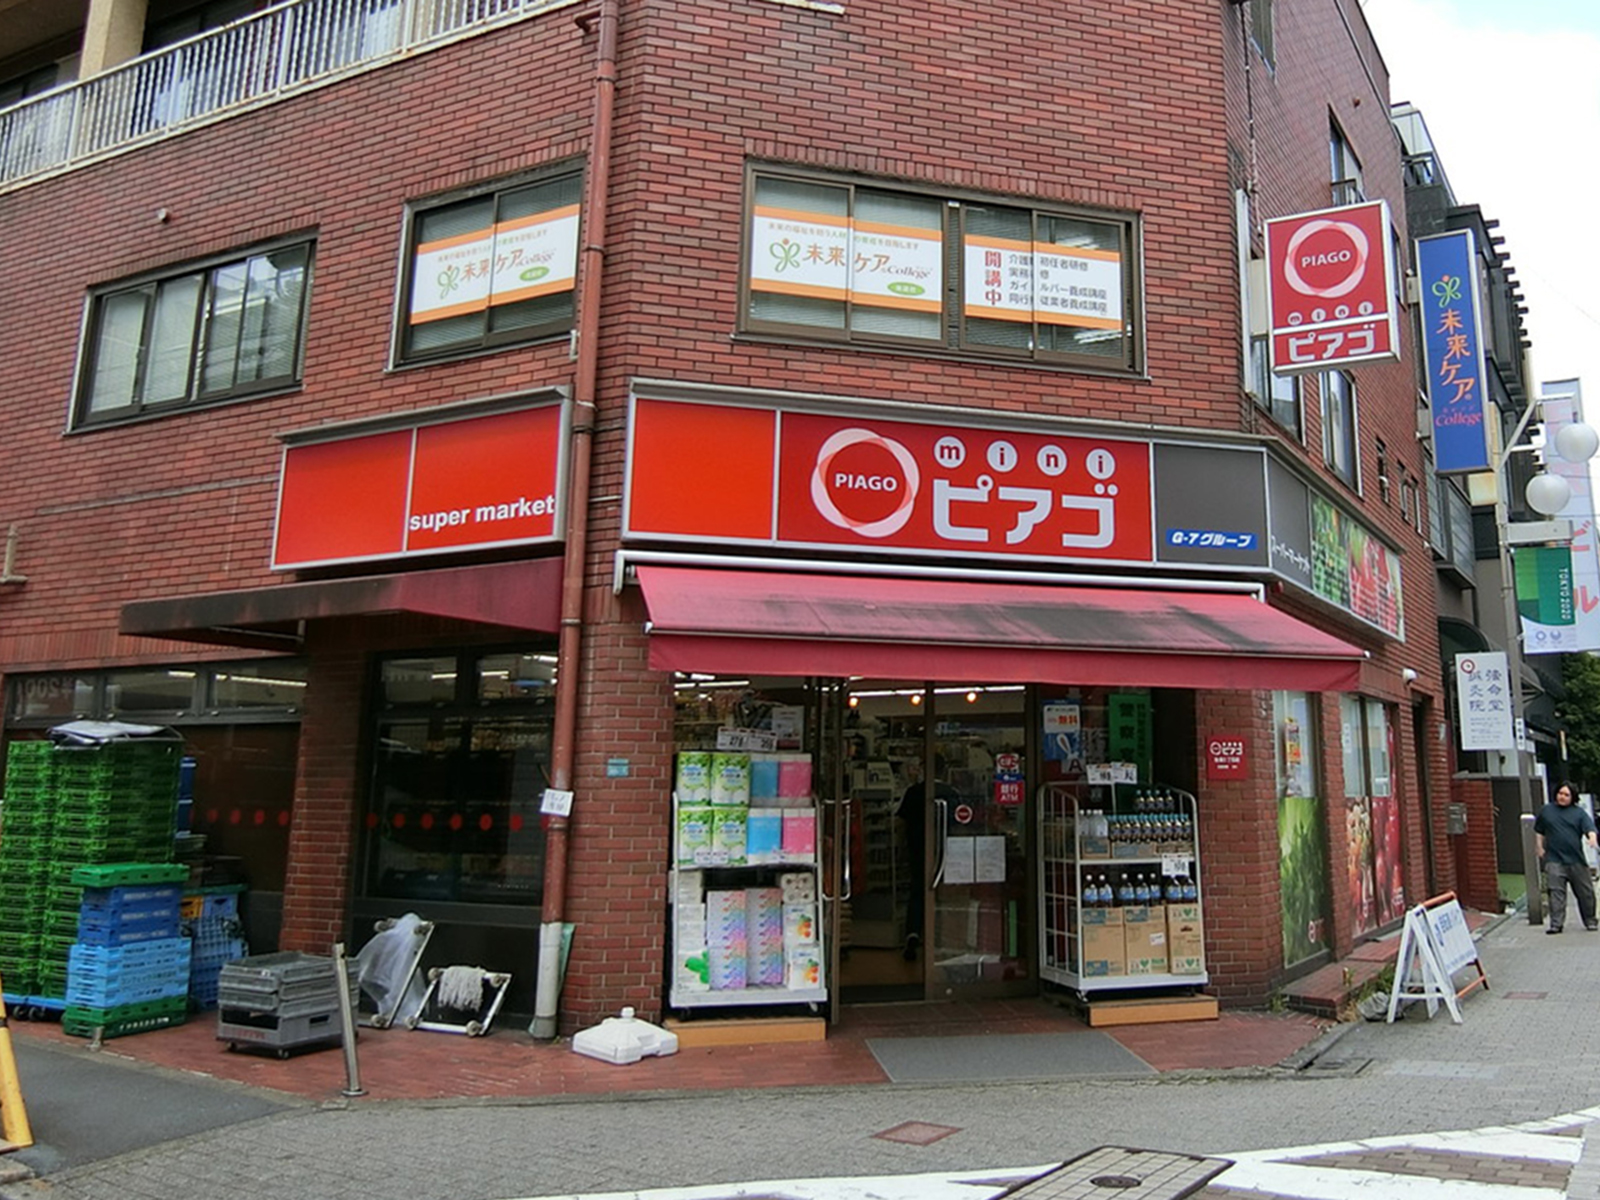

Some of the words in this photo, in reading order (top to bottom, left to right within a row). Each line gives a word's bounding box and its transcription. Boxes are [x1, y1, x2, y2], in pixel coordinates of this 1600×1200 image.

[460, 248, 524, 282] 未来ケア
[803, 243, 890, 273] 未来ケア
[888, 264, 931, 280] College
[1301, 249, 1351, 268] PIAGO
[985, 251, 1002, 306] 開講中
[1289, 302, 1371, 325] mini
[1288, 323, 1376, 363] ピアゴ
[1436, 308, 1475, 404] 未来ケア
[1435, 410, 1482, 428] College
[937, 440, 1110, 477] mini
[835, 473, 897, 493] PIAGO
[409, 507, 472, 534] super
[475, 495, 555, 523] market
[933, 474, 1119, 549] ピアゴ
[1559, 567, 1569, 597] TOKYO
[1561, 598, 1571, 620] 2020
